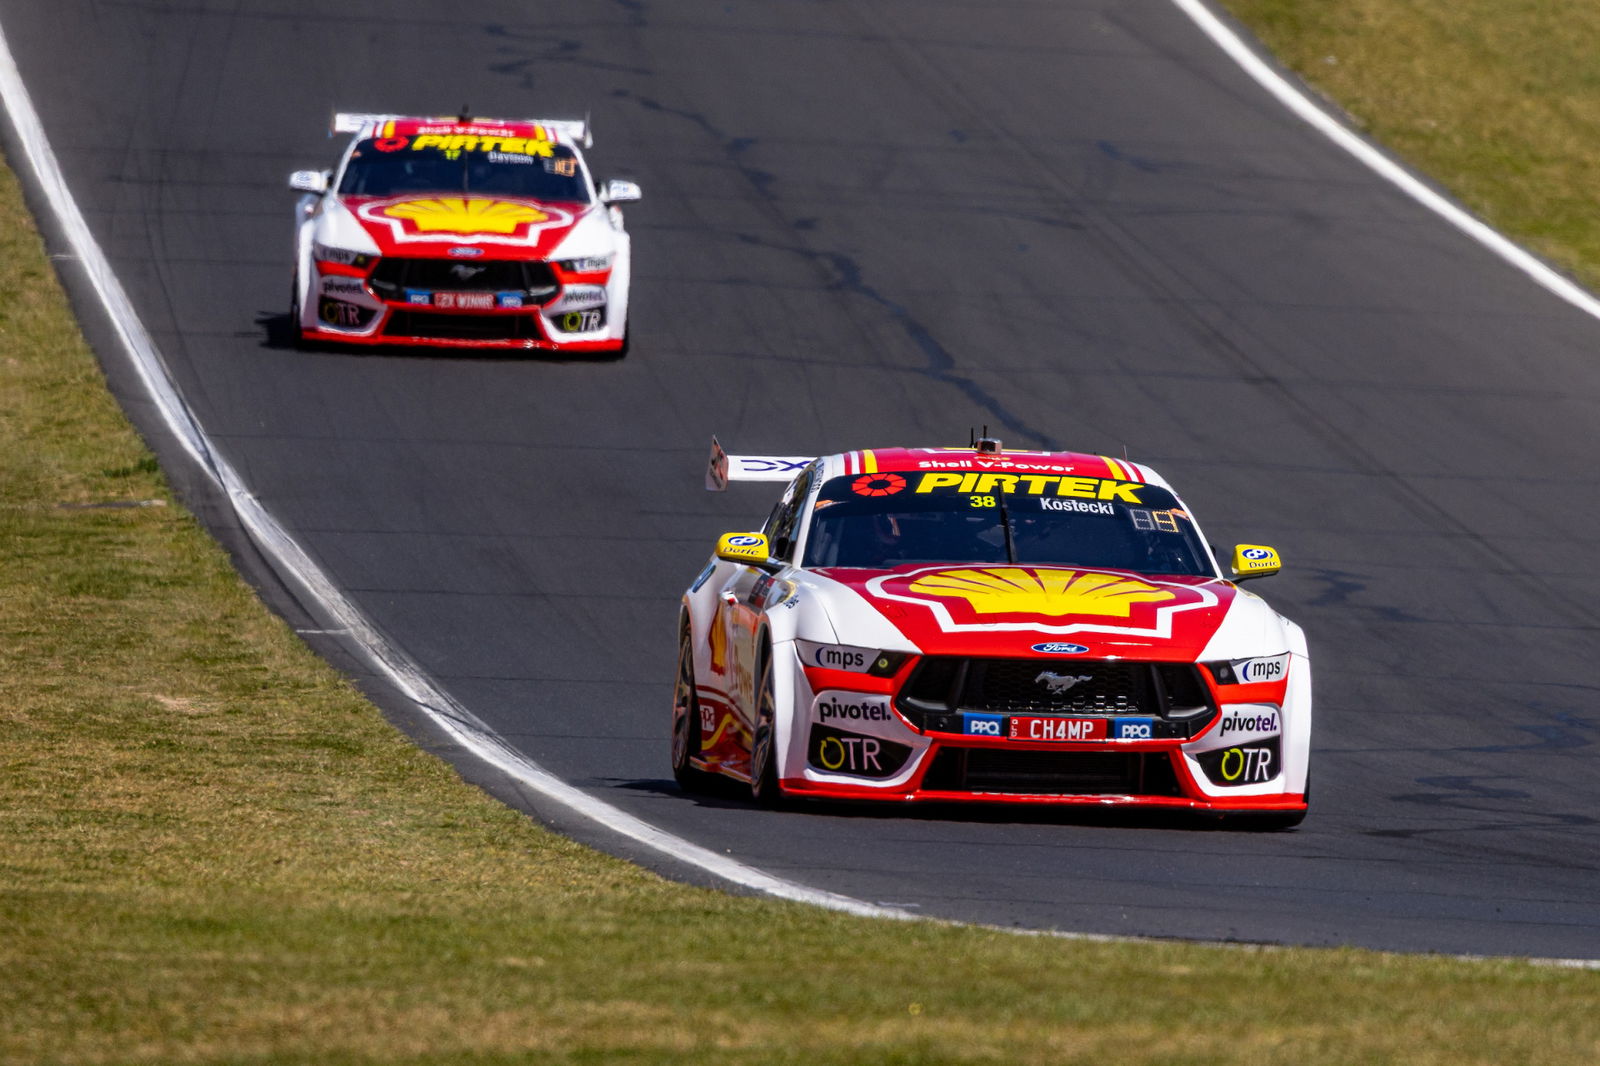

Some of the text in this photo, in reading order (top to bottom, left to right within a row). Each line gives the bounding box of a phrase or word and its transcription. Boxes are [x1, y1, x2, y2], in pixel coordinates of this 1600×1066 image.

[411, 134, 555, 157] PIRTEK
[563, 311, 601, 331] OTR
[918, 460, 1075, 473] Shell V-Power
[915, 473, 1145, 504] PIRTEK
[970, 496, 996, 508] 38
[1039, 498, 1115, 516] Kostecki
[722, 546, 759, 556] Doric
[1249, 560, 1278, 569] Doric
[1043, 642, 1077, 653] Ford
[826, 650, 864, 669] mps
[1253, 660, 1280, 677] mps
[970, 720, 999, 735] PPQ
[1030, 719, 1094, 740] CH4MP
[1121, 724, 1150, 738] PPQ
[820, 736, 882, 770] OTR
[1221, 748, 1271, 782] OTR
